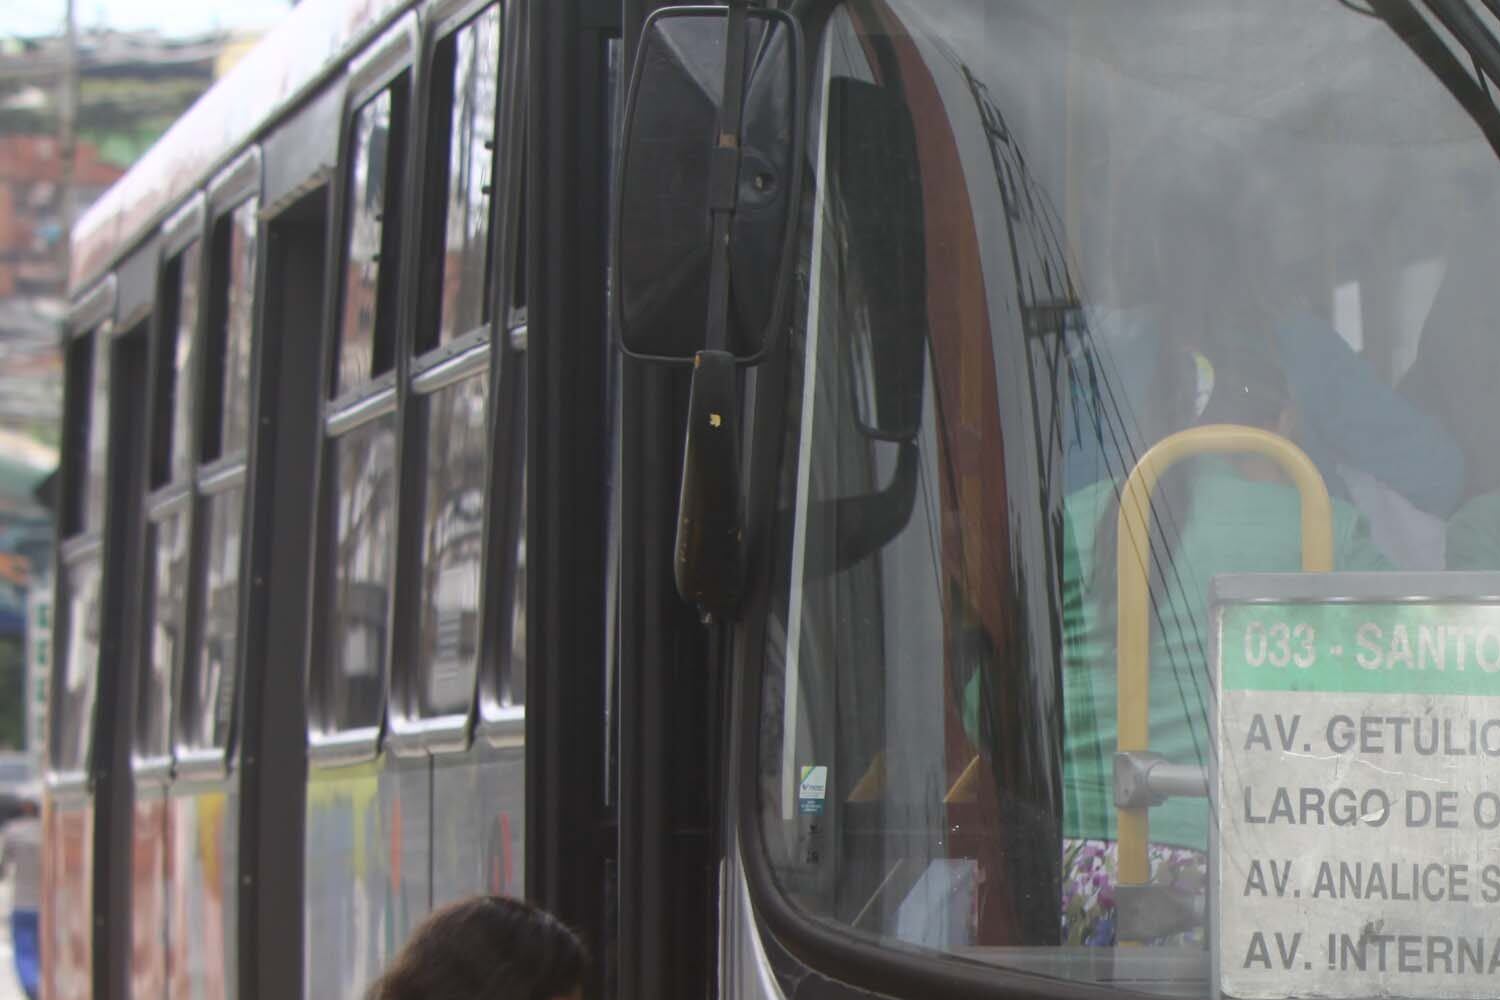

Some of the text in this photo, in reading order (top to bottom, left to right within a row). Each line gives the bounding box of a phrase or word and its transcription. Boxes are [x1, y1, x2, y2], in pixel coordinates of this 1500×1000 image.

[1244, 621, 1316, 669] 033
[1243, 713, 1311, 753] AV.
[1243, 786, 1391, 829] LARGO
[1404, 790, 1459, 829] DE
[1243, 859, 1302, 899] AV.
[1312, 860, 1469, 903] ANALICE
[1243, 931, 1312, 971] AV.
